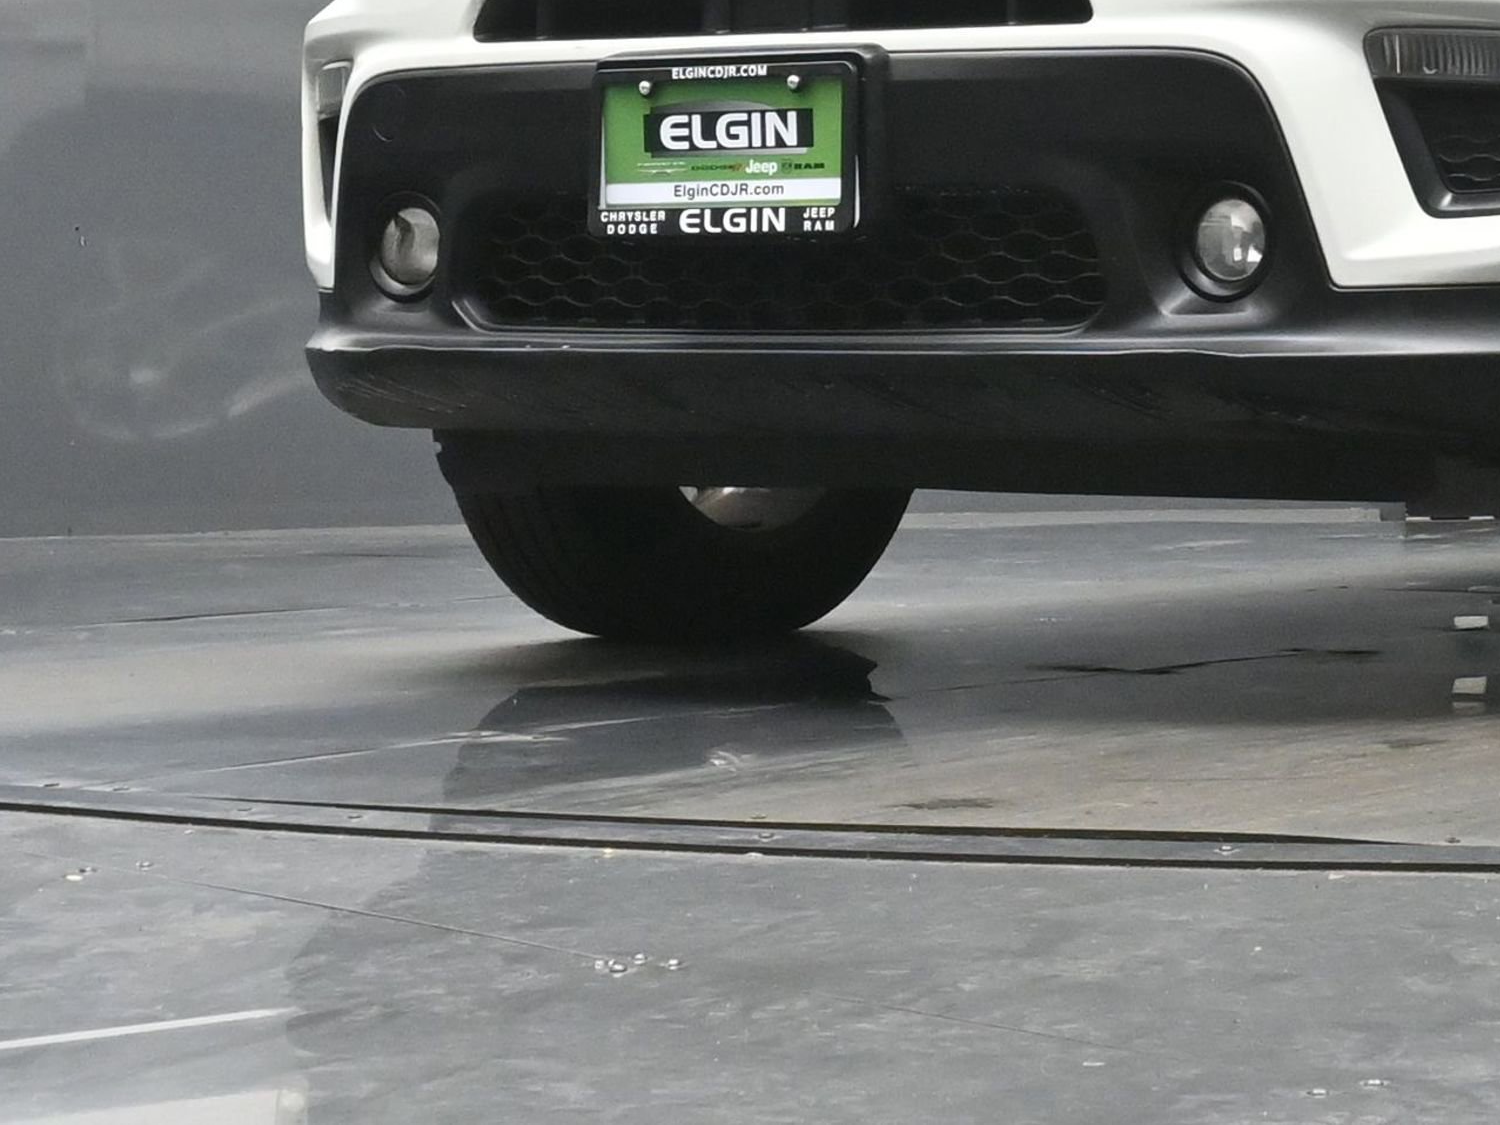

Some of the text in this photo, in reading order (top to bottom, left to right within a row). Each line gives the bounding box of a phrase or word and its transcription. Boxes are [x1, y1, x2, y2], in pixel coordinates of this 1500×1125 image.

[672, 65, 768, 80] ELGINCDJR.COM
[659, 110, 799, 150] ELGIN
[745, 159, 778, 175] Jeep
[794, 162, 825, 170] RAM
[673, 183, 785, 200] ElginCDJR.com
[601, 210, 666, 223] CHRYSLER
[679, 207, 786, 233] ELGIN
[803, 207, 836, 219] JEEP
[606, 224, 658, 235] DODGE
[803, 220, 835, 231] RAM
